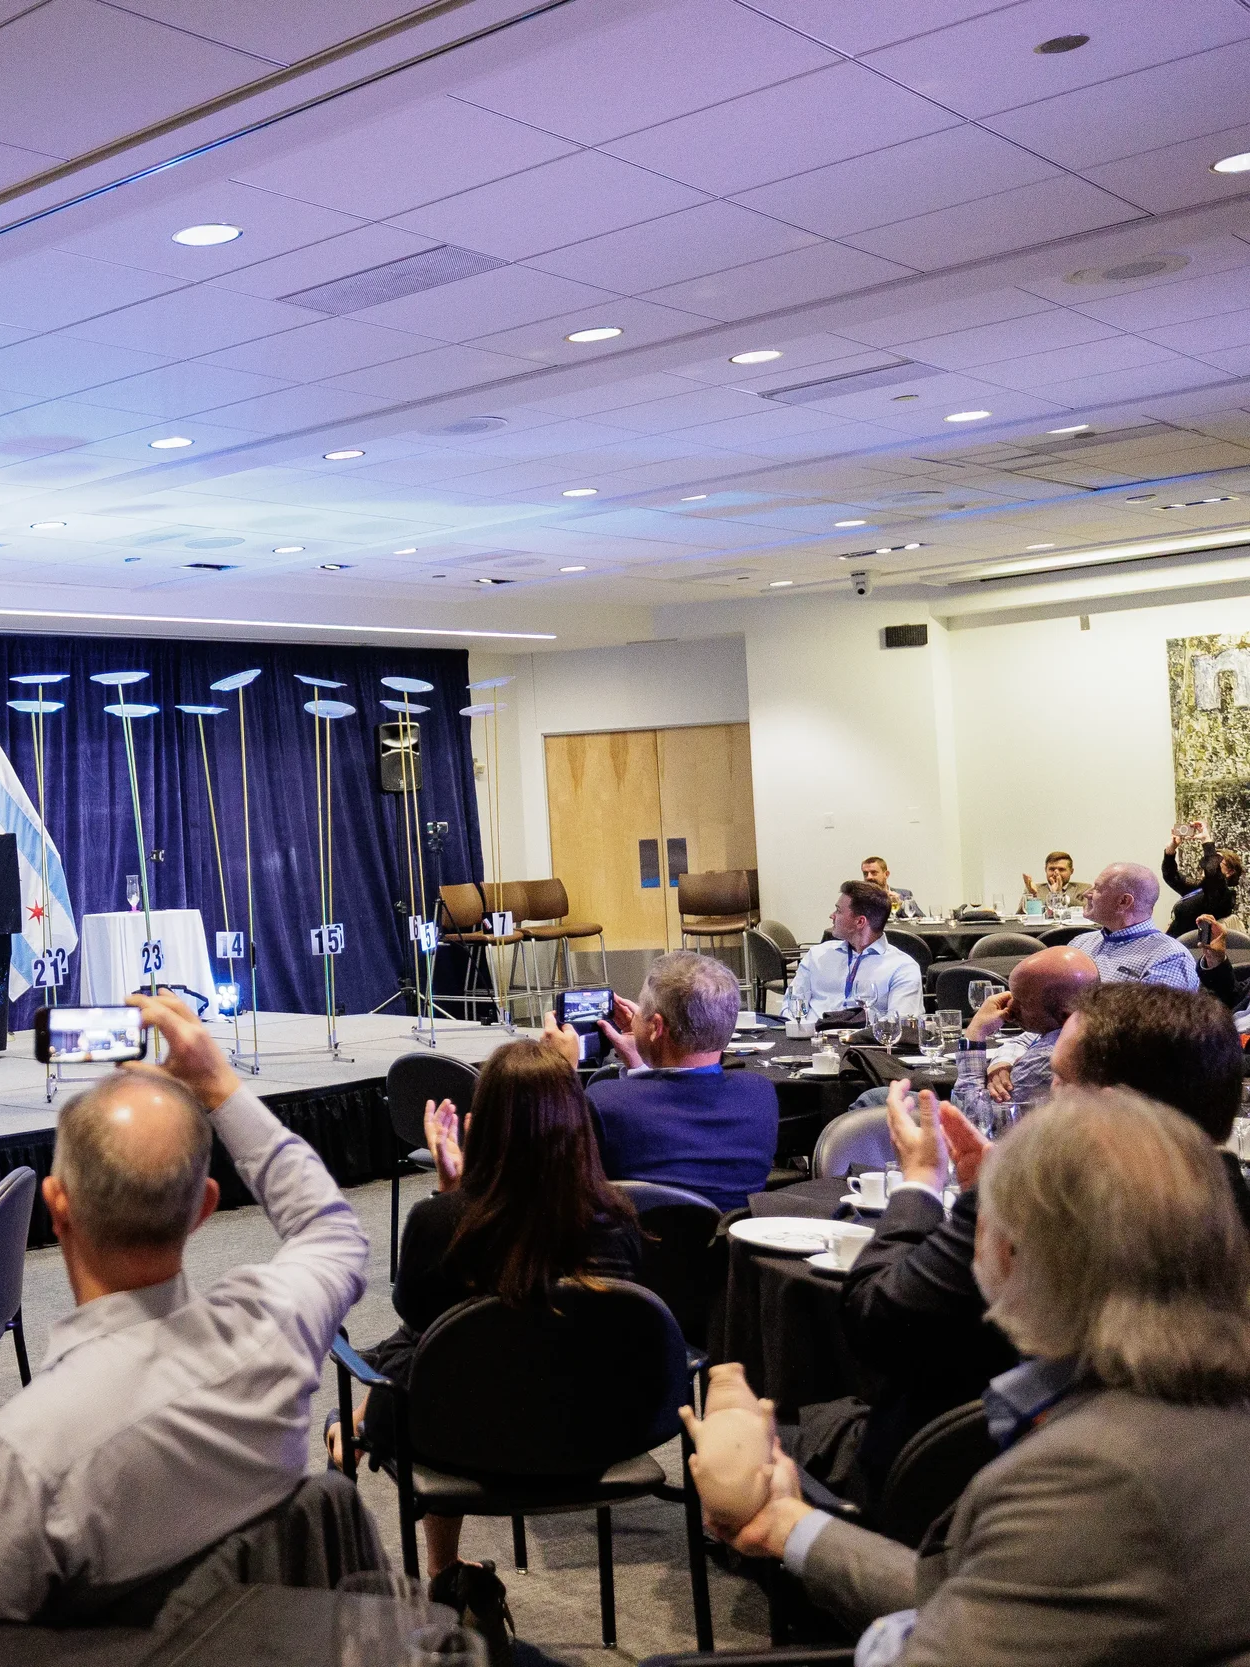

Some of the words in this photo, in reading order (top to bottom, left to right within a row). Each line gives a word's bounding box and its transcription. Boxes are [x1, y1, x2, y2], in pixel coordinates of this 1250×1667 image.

[219, 933, 243, 956] 14
[315, 929, 339, 953] 15
[33, 958, 60, 986] 21
[142, 945, 162, 973] 23
